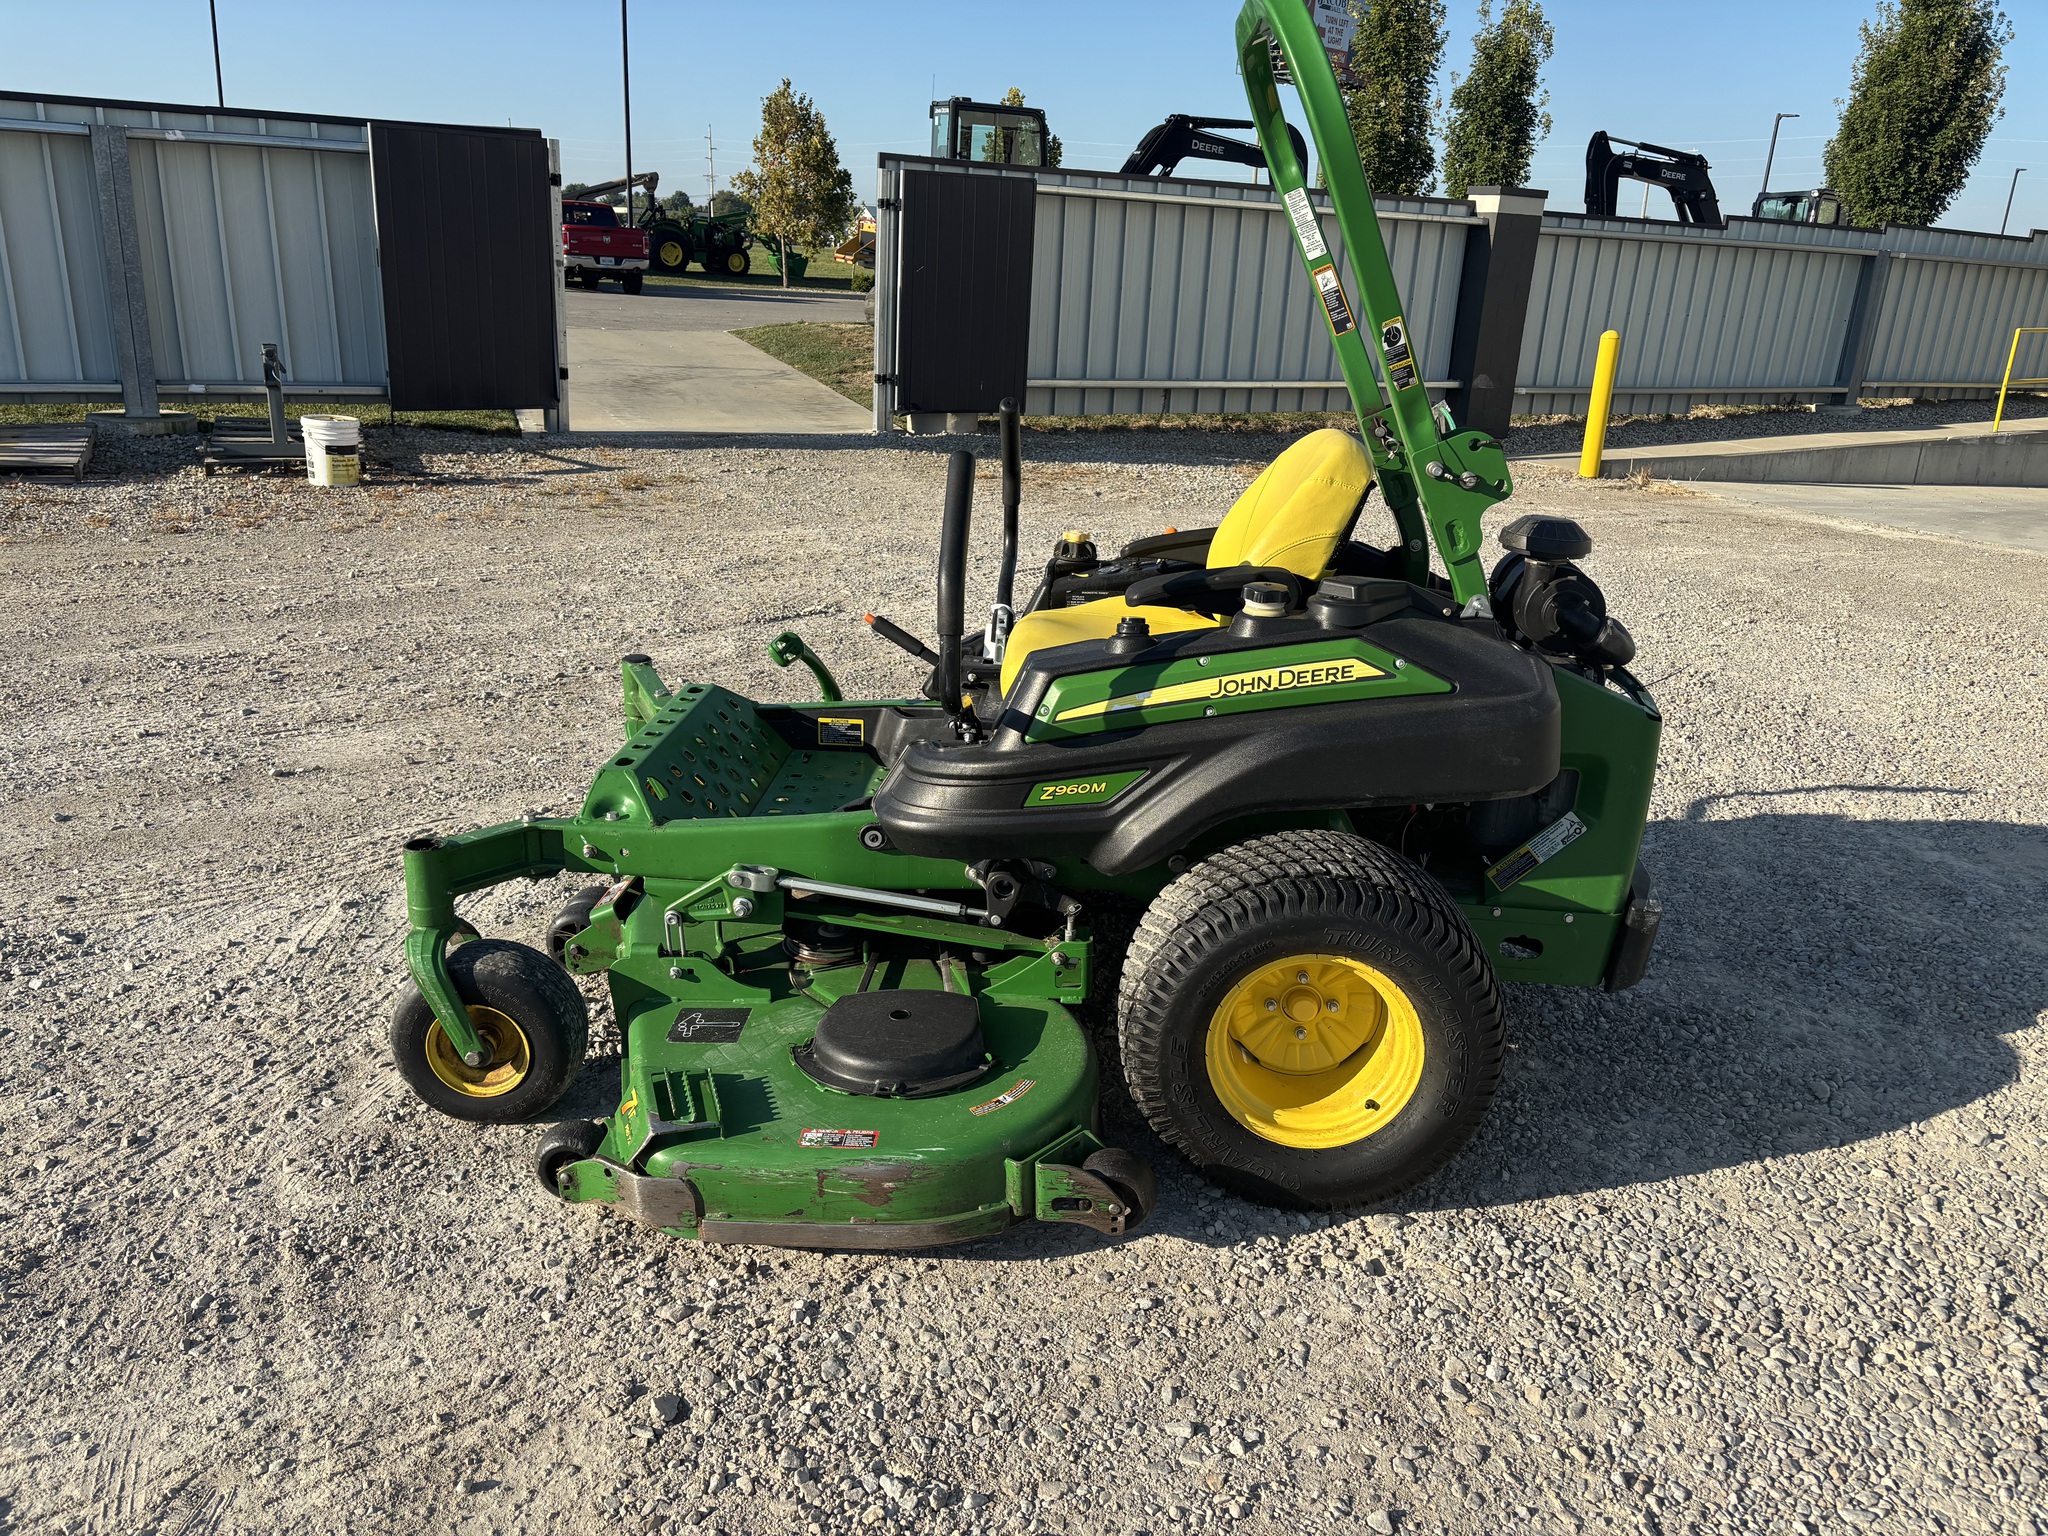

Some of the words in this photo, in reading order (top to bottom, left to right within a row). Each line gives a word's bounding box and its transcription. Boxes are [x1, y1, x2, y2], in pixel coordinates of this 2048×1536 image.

[1325, 15, 1338, 25] TURN
[1339, 18, 1349, 28] LEFT
[1328, 26, 1334, 35] AT
[1335, 28, 1344, 37] THE
[1328, 36, 1342, 46] LIGHT
[1191, 139, 1225, 155] DEERE
[1661, 168, 1686, 181] DEERE
[1210, 674, 1272, 696] JOHN
[1278, 664, 1355, 688] DEERE
[1039, 782, 1107, 800] Z960M
[1323, 928, 1424, 969] TURF
[1416, 974, 1469, 1118] MASTER
[1170, 1035, 1274, 1180] CARLISLE
